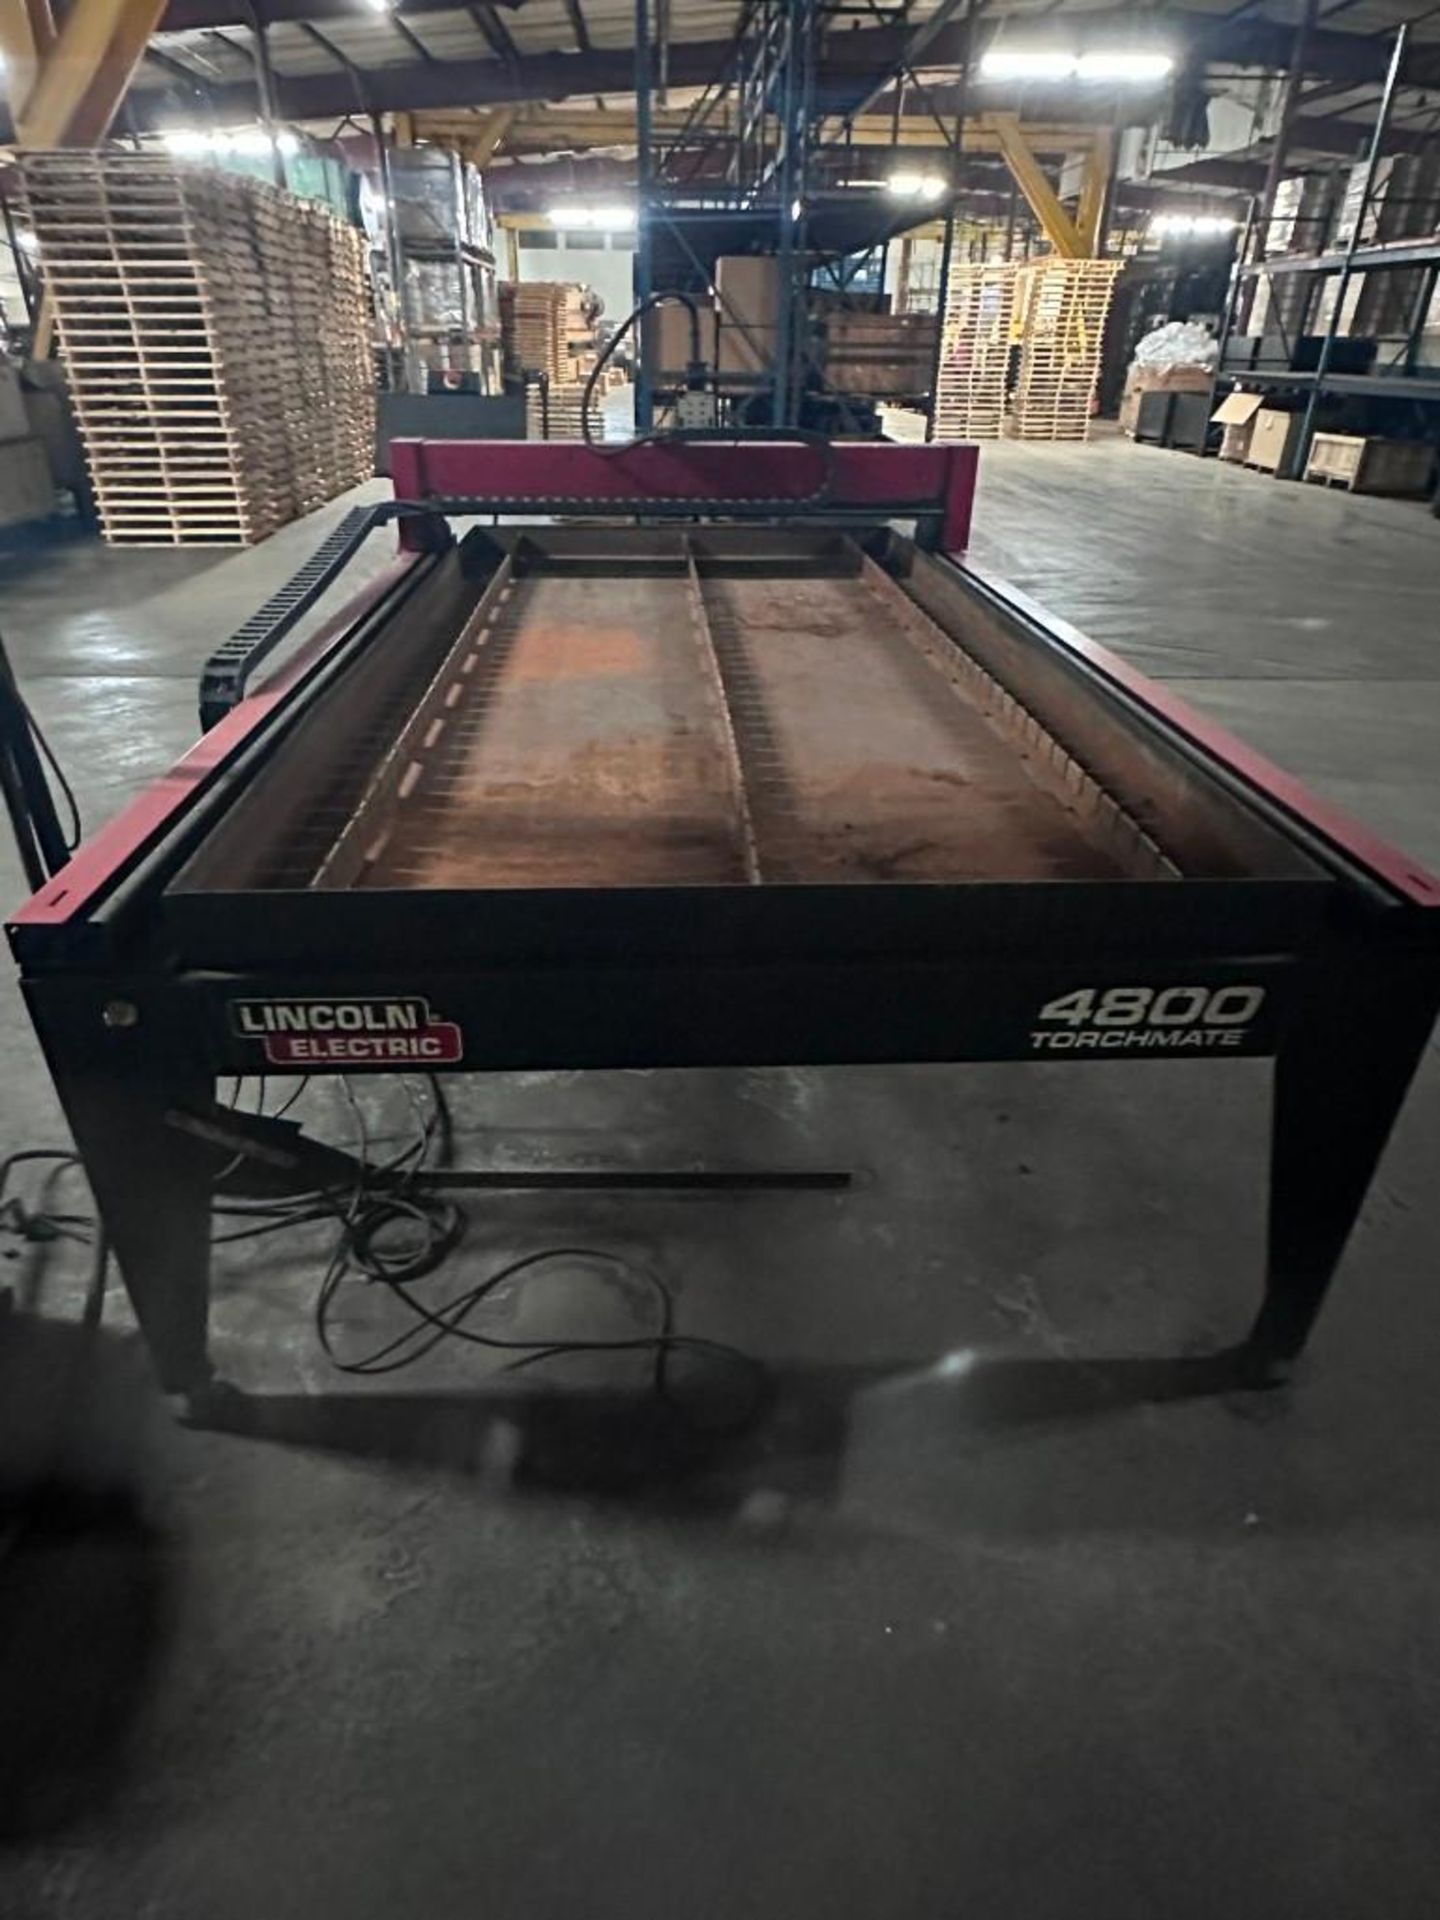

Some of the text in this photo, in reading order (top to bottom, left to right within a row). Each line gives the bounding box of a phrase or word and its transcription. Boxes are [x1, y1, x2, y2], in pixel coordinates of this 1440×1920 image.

[1038, 986, 1265, 1026] 4800
[240, 1005, 418, 1031] LINCOLN
[290, 1038, 442, 1057] ELECTRIC
[1031, 1030, 1243, 1049] TORCHMATE
